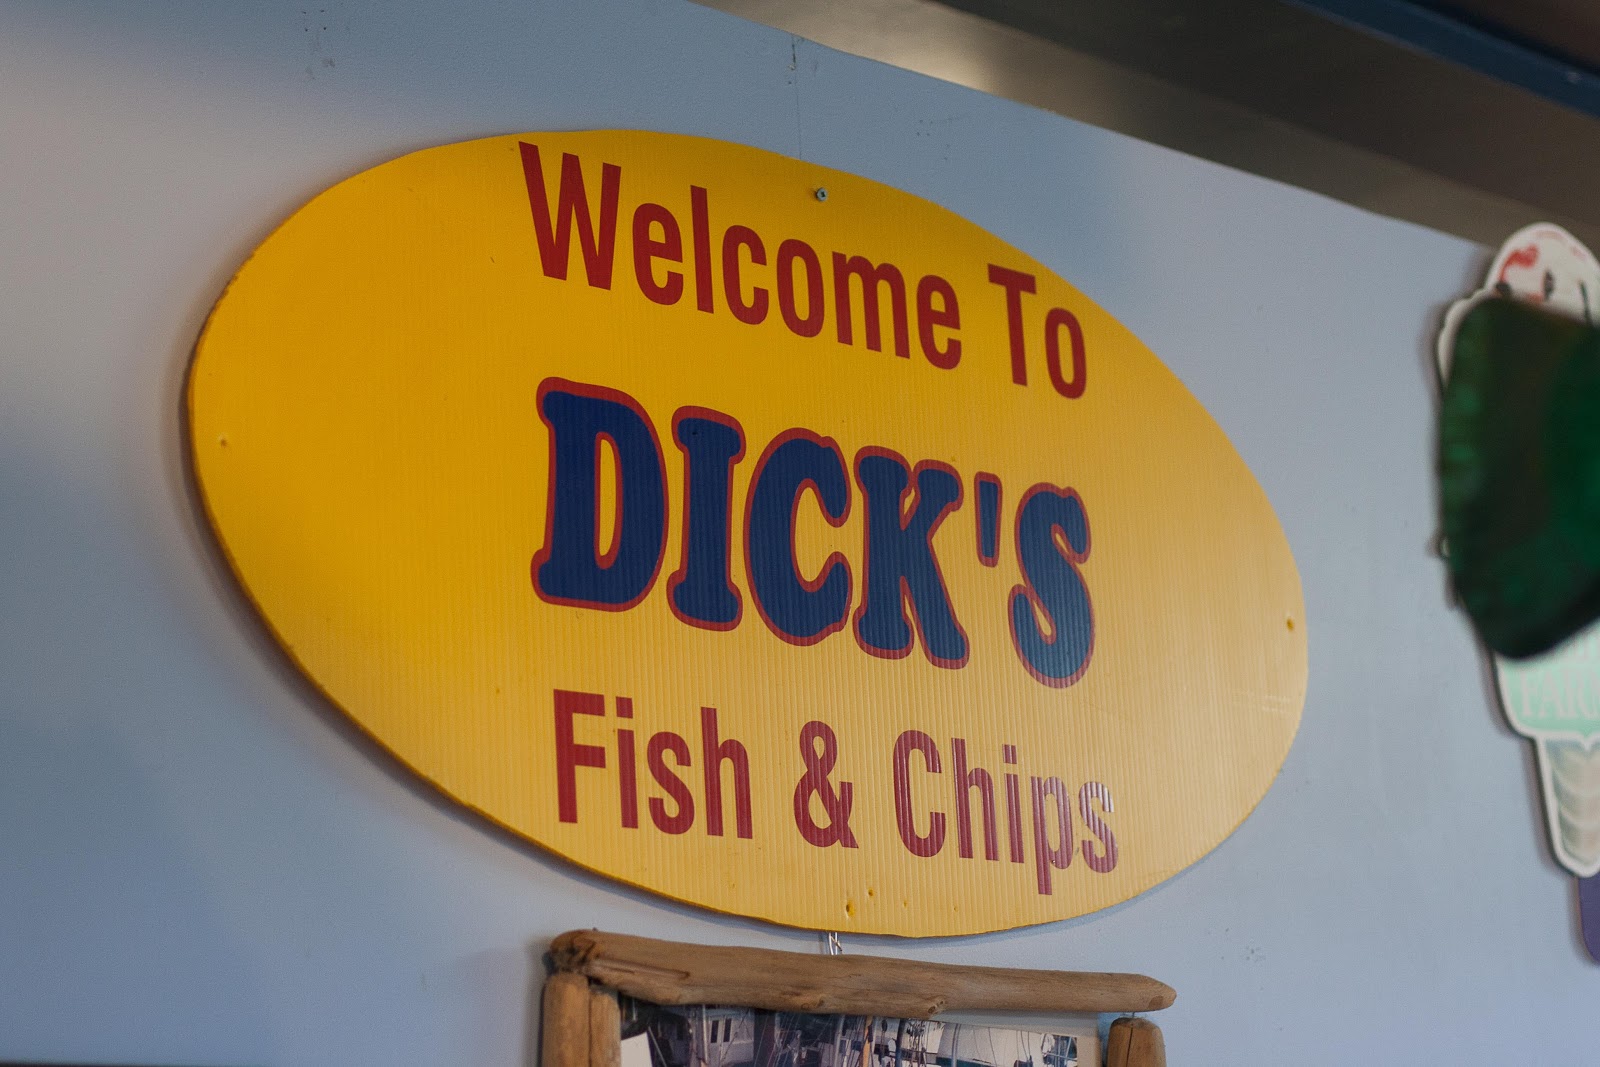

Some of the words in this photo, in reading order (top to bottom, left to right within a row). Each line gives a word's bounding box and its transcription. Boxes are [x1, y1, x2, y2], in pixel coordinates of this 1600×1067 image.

[517, 140, 962, 371] Welcome
[987, 263, 1087, 400] To
[530, 376, 1093, 689] DICK'S
[553, 688, 753, 840] Fish
[793, 720, 859, 849] &
[892, 729, 1119, 896] Chips
